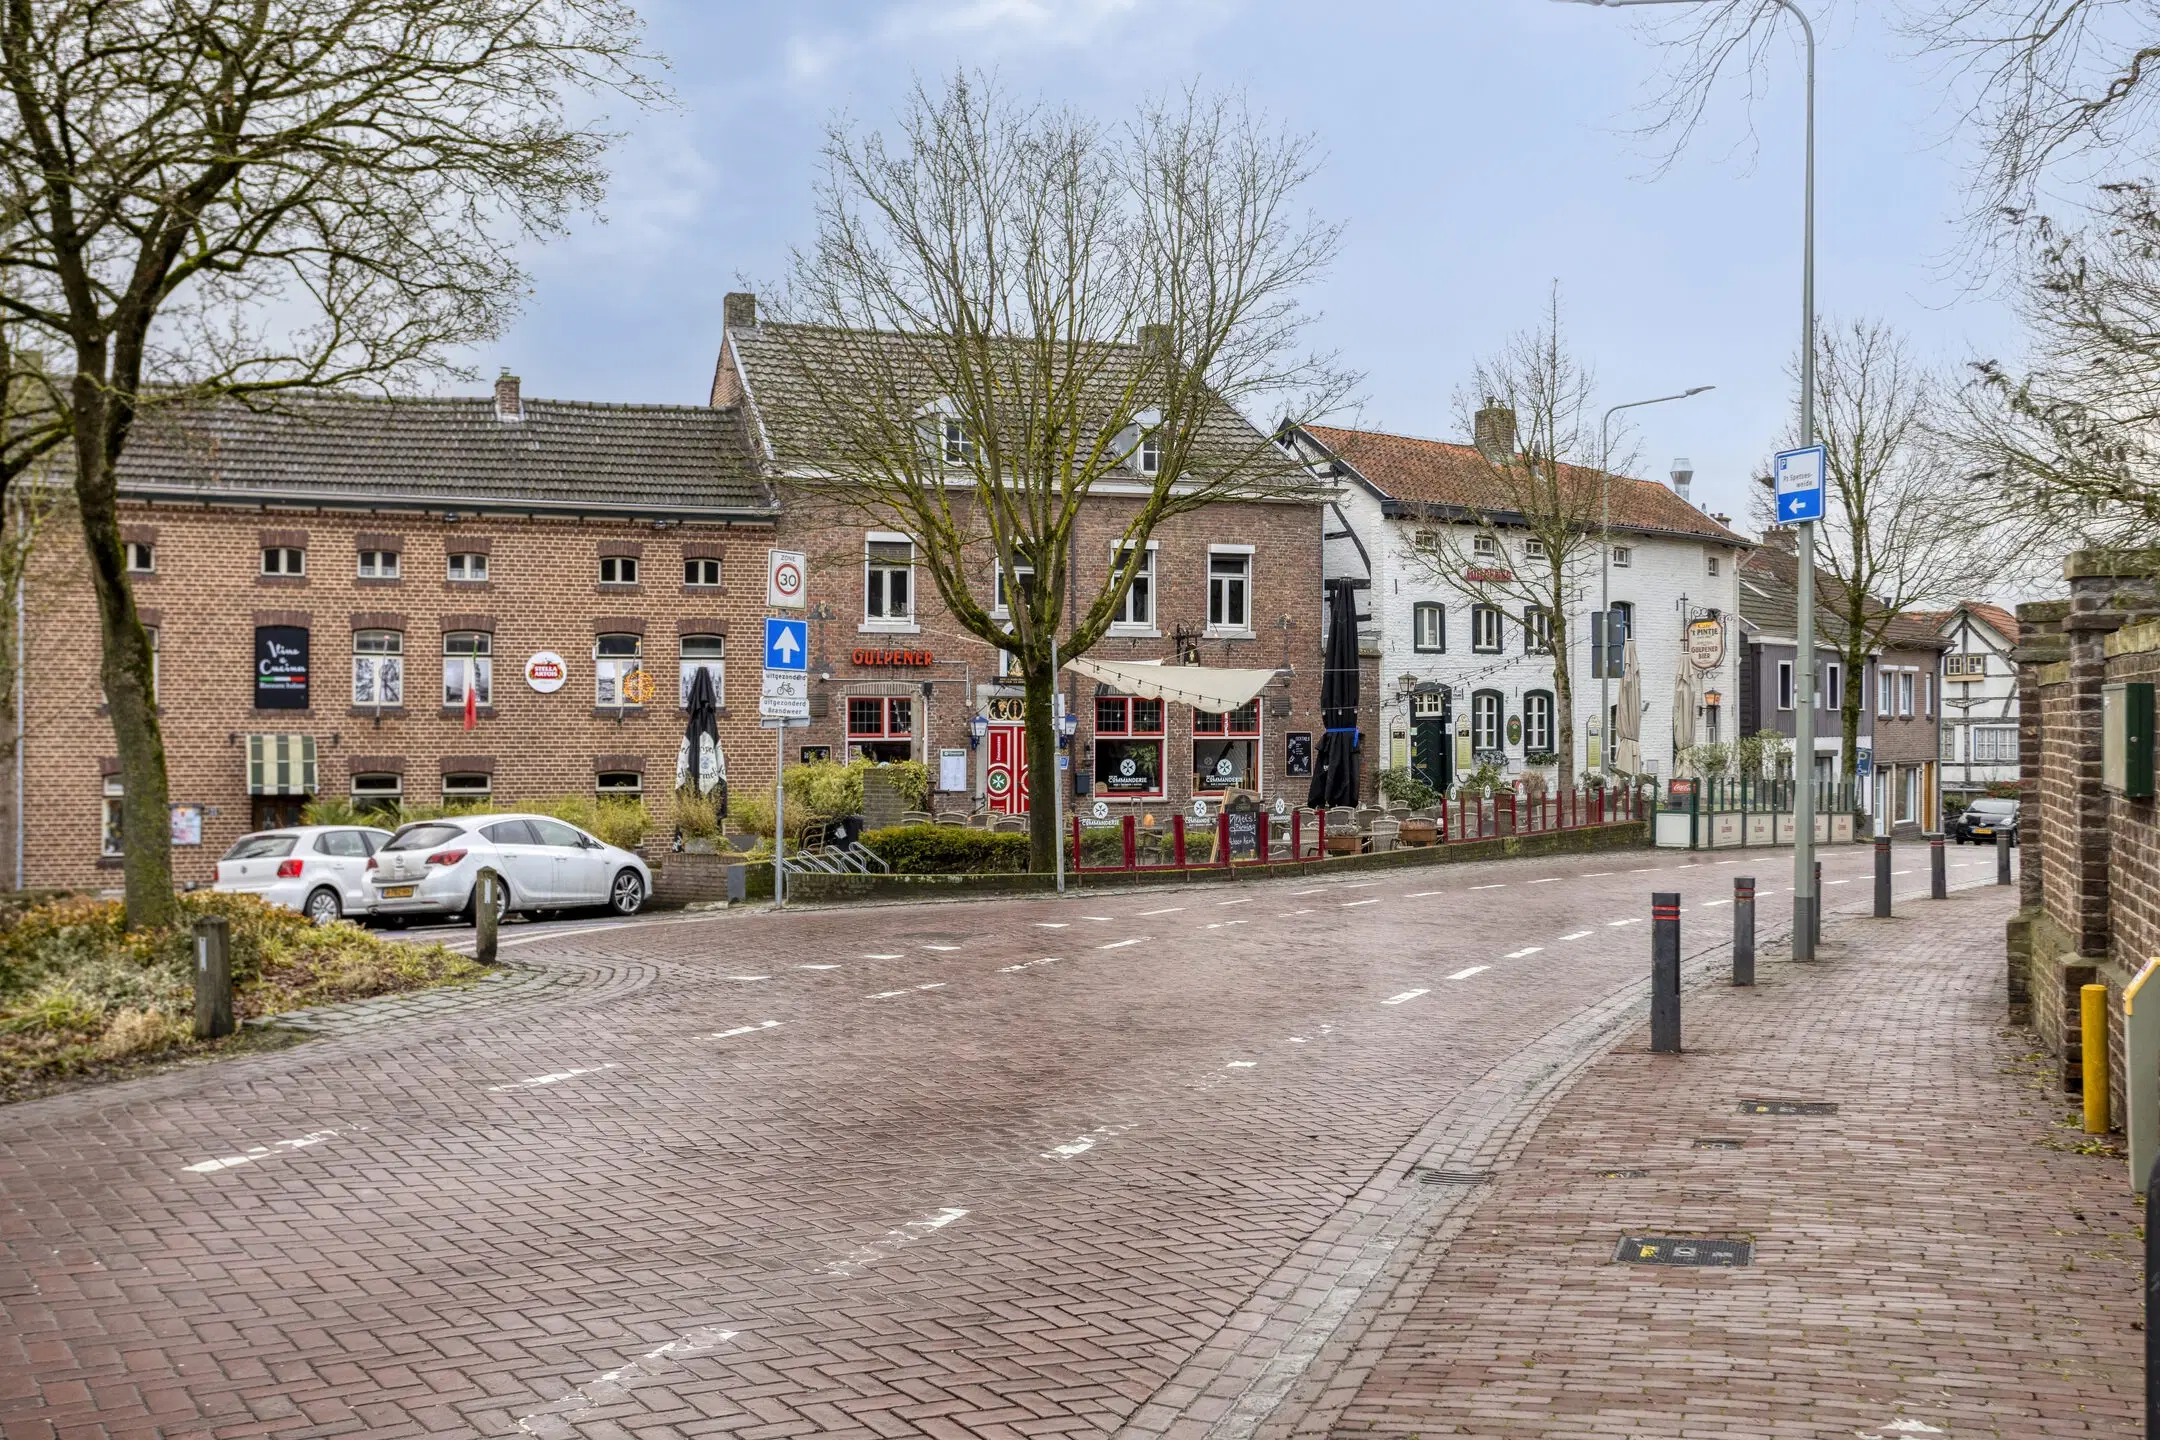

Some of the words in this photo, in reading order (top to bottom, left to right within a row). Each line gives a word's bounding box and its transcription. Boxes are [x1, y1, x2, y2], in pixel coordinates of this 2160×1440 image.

[780, 573, 797, 587] 30
[1697, 628, 1719, 637] PINTJE
[852, 648, 934, 665] GULPENER
[259, 659, 306, 675] Cucina
[763, 699, 807, 707] uitgezonderd
